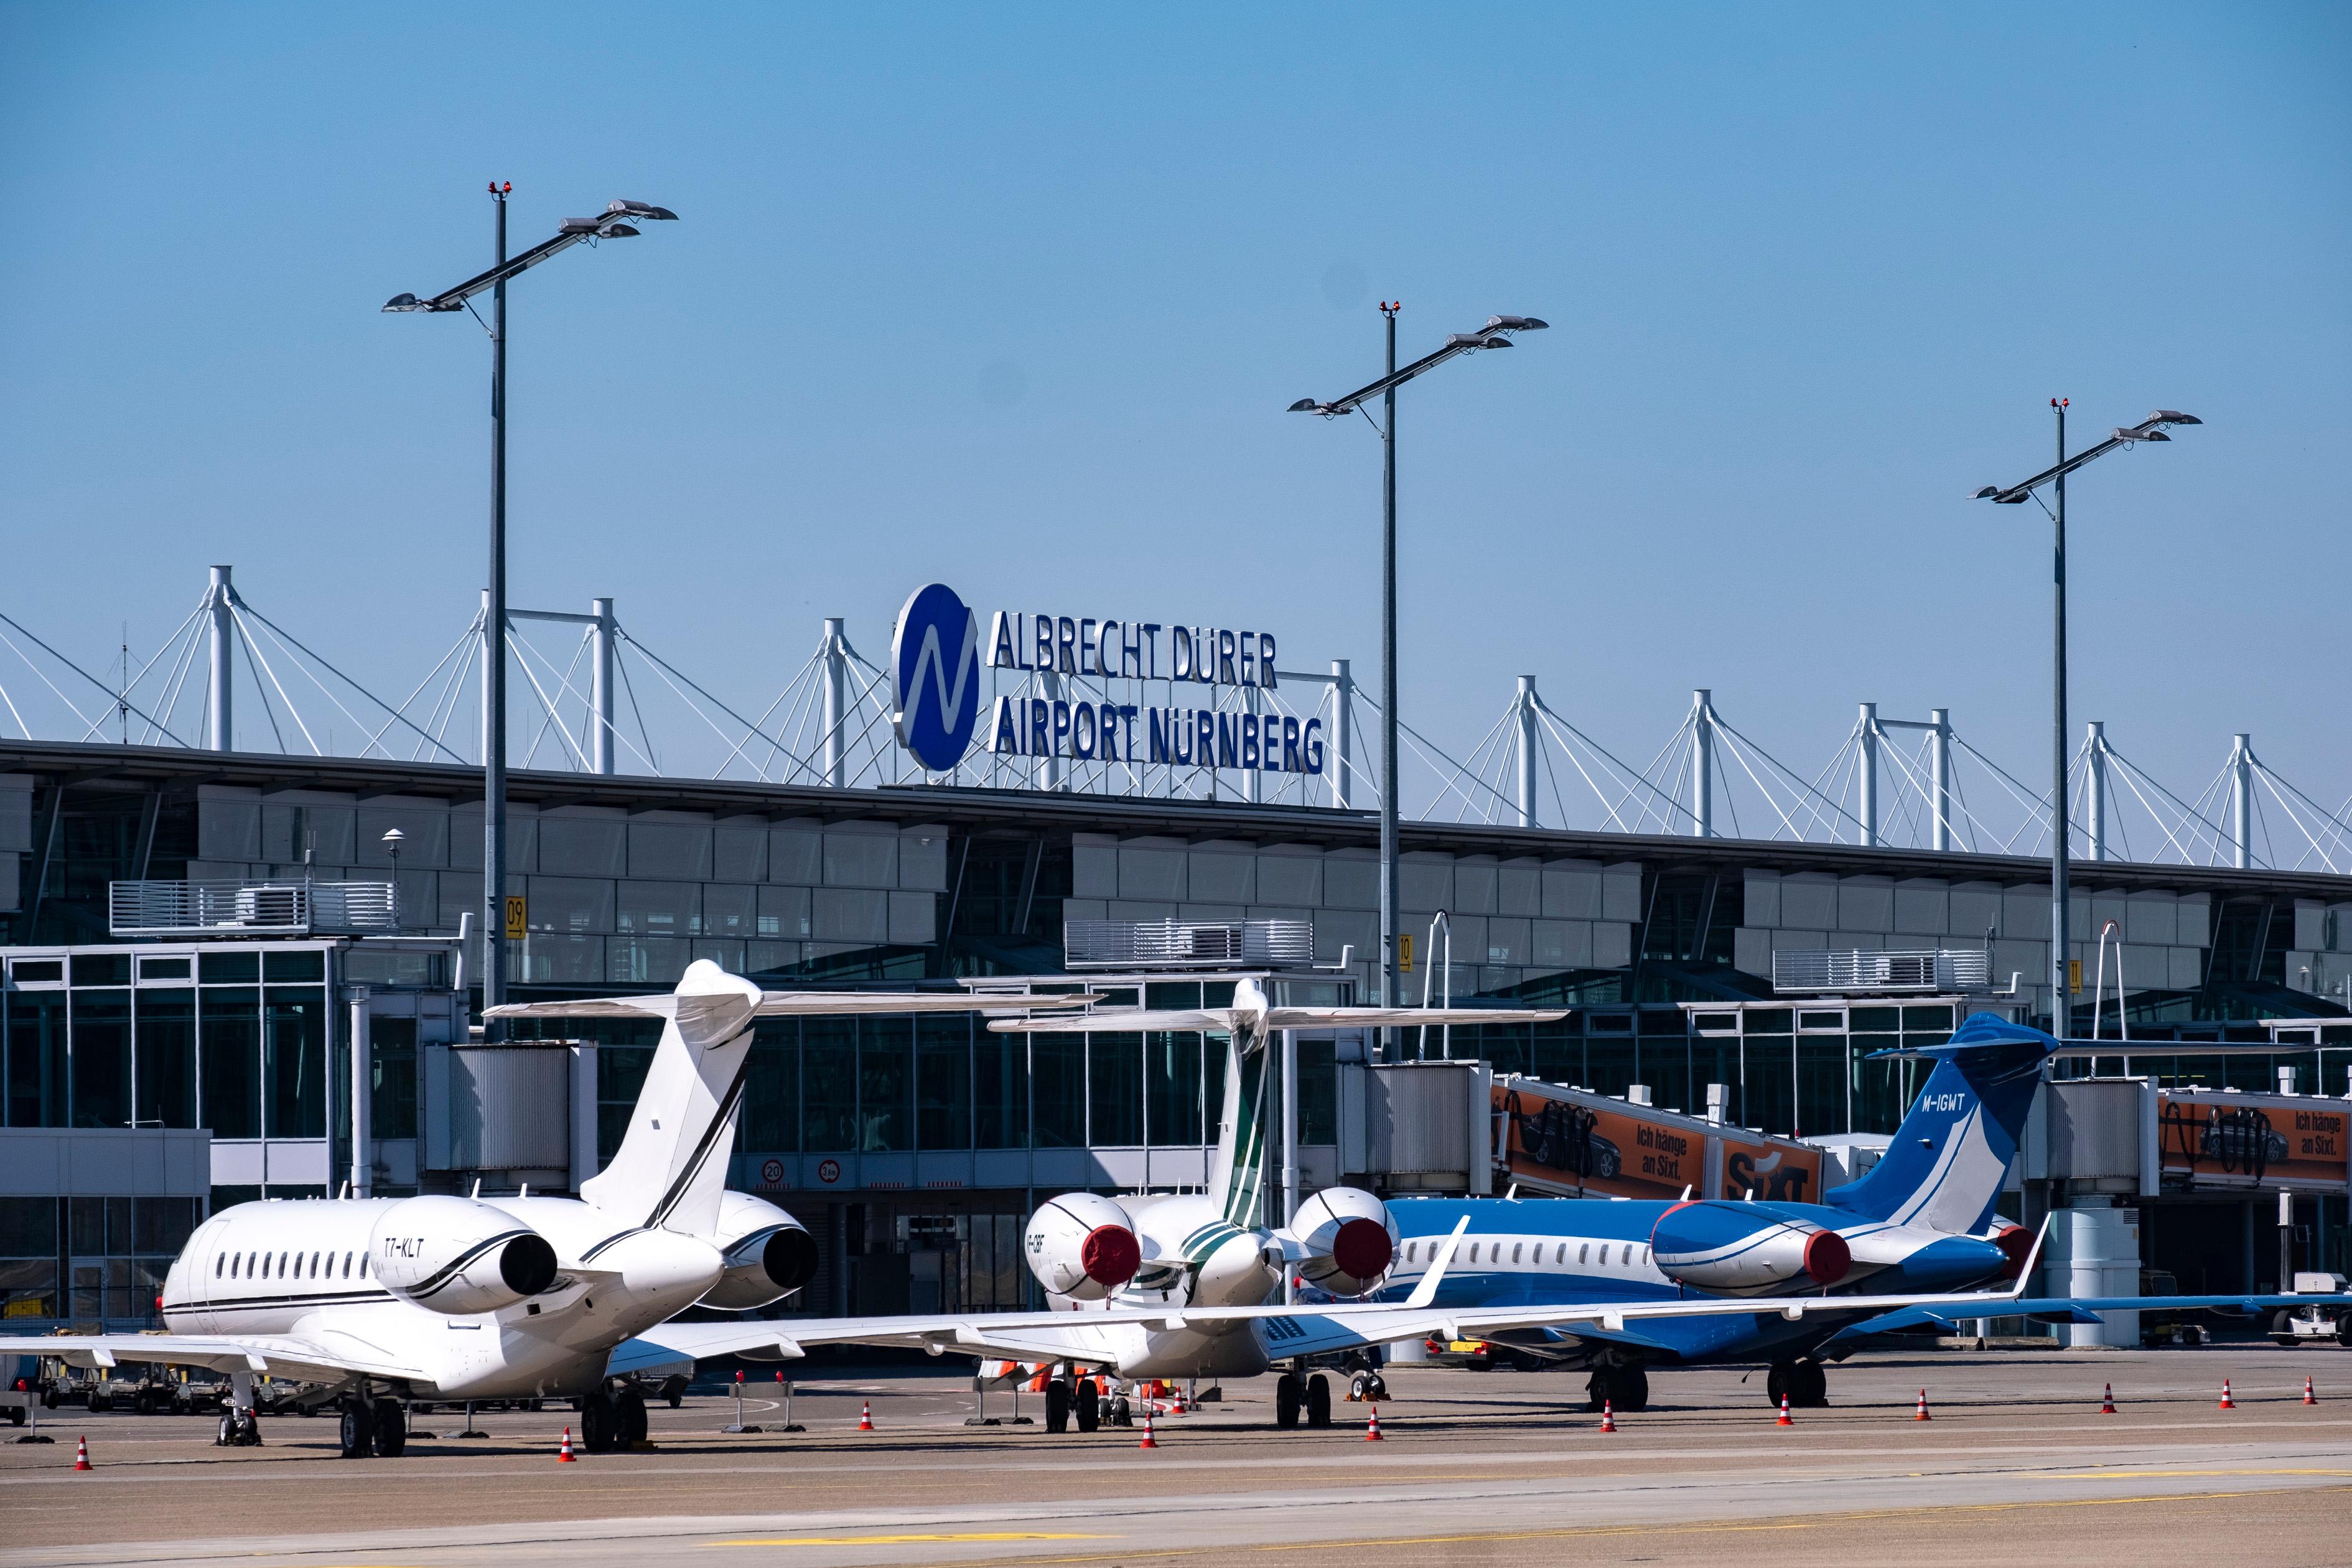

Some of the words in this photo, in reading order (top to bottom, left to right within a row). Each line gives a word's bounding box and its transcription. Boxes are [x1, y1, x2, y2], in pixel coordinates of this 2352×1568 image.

[992, 610, 1160, 680] ALBRECHT
[1171, 625, 1277, 689] DÜRER
[994, 696, 1138, 762] AIRPORT
[1146, 706, 1323, 775] NÜRNBERG
[507, 900, 523, 926] 09
[1400, 937, 1410, 960] 10
[2071, 962, 2078, 982] 11
[1921, 1093, 1966, 1113] M-IGWT
[2295, 1111, 2310, 1131] Ich
[2312, 1111, 2341, 1134] hänge
[1637, 1124, 1653, 1148] Ich
[1655, 1128, 1687, 1156] hänge
[2302, 1137, 2313, 1154] an
[2315, 1134, 2337, 1156] Sixt.
[767, 1165, 780, 1177] 20
[1642, 1155, 1655, 1174] an
[1657, 1155, 1681, 1181] Sixt.
[385, 1238, 424, 1258] T7-KLT
